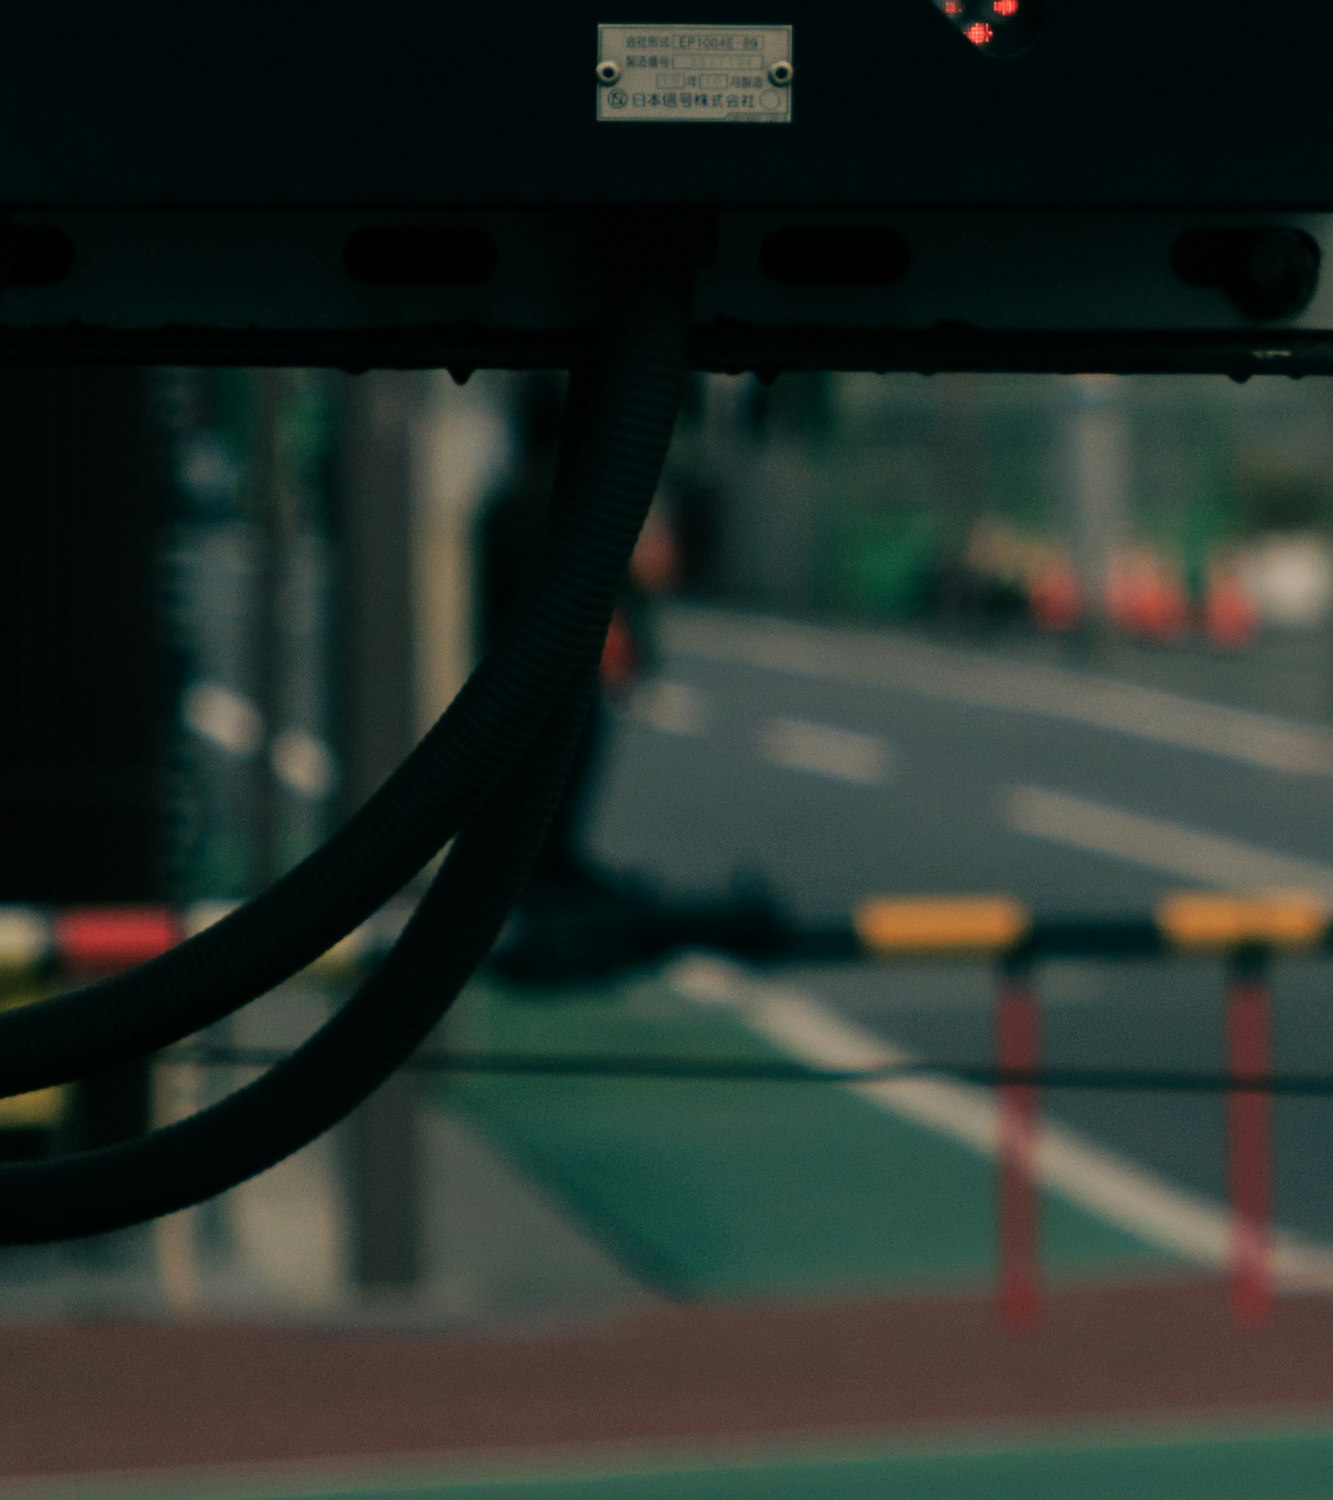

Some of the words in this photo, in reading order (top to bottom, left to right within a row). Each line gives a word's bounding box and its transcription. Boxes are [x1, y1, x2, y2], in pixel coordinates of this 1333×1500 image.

[631, 92, 756, 109] 日本信号株式会社
